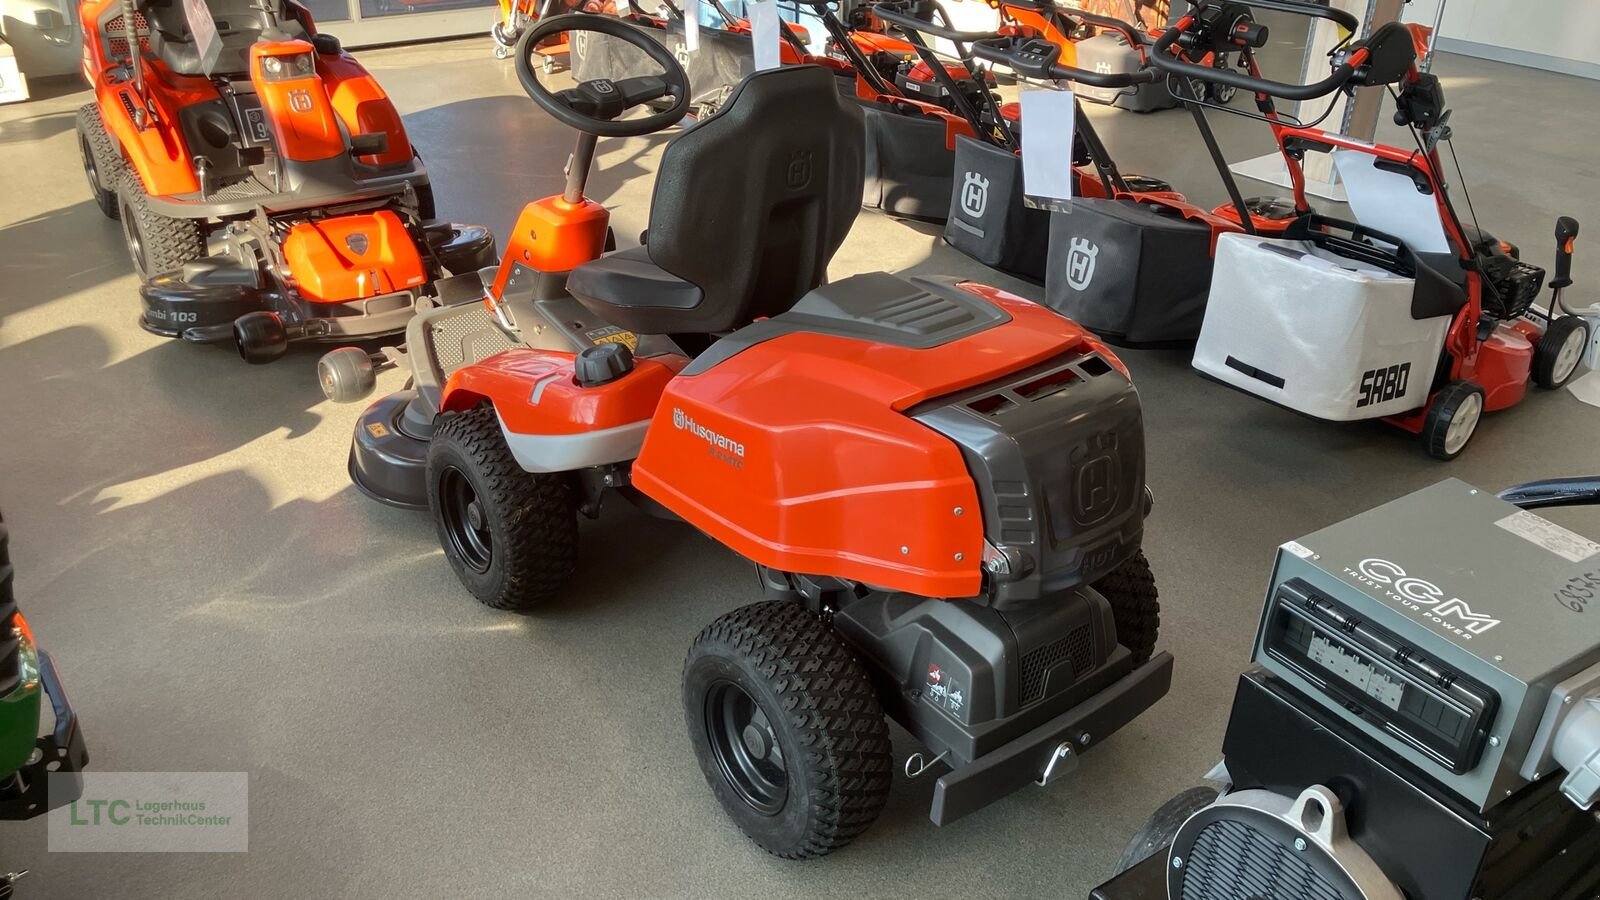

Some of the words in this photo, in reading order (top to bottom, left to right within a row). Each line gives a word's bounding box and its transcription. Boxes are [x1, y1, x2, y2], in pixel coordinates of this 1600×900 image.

[148, 309, 167, 321] mbi
[170, 311, 198, 323] 103
[1356, 361, 1412, 409] SABO
[684, 414, 745, 458] Husqvarna
[1343, 566, 1382, 590] TRUST
[1385, 590, 1420, 612] YOUR
[1423, 611, 1473, 641] POWER
[1358, 558, 1502, 635] CGM
